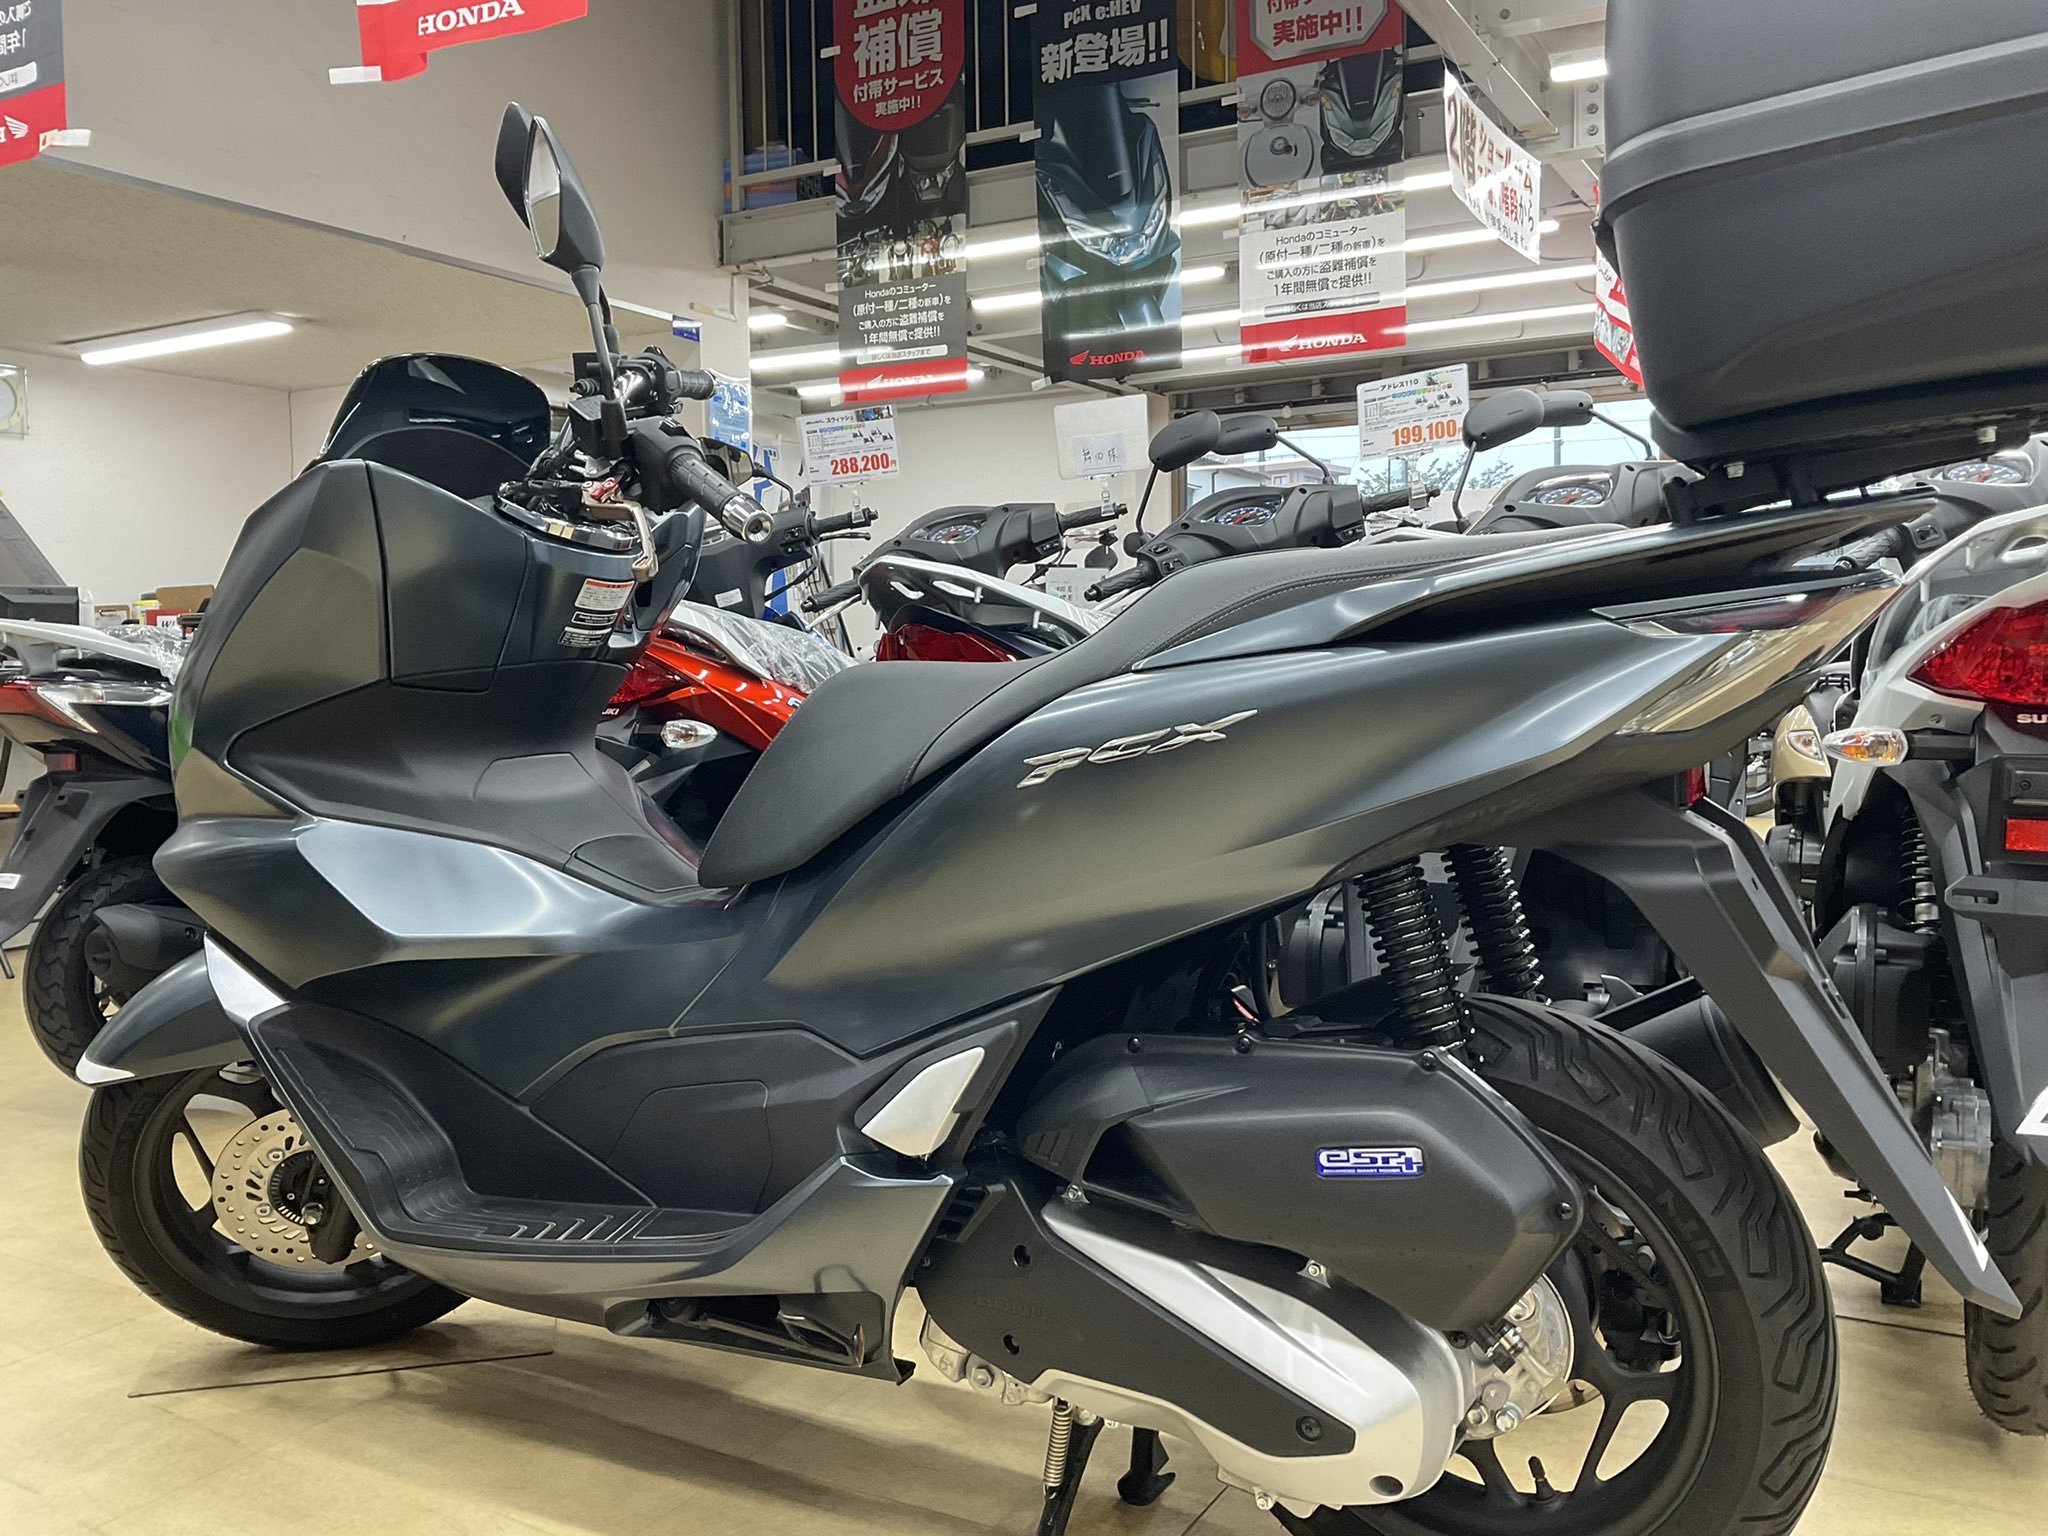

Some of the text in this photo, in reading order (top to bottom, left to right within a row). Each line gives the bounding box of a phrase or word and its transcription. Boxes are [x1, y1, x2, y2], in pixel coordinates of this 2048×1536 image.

[418, 0, 525, 36] HONDA
[1063, 0, 1142, 29] PCX e:HEV
[1273, 6, 1363, 47] 実施中!!
[853, 8, 943, 78] 補償
[1040, 18, 1169, 84] 新登場!!
[853, 68, 944, 104] 付帯サービス
[875, 95, 921, 118] 実施中!!
[1275, 225, 1368, 246] Hondaのコミューター
[1266, 256, 1378, 281] ご購入の方に盗難補償を
[864, 282, 937, 299] Hondaのコミューター
[1273, 272, 1372, 297] 1年間無償で提供!!
[858, 310, 945, 331] ご購入の方に盗難補償を
[863, 325, 941, 345] 1年間無償で提供!!
[1298, 333, 1368, 351] HONDA
[1089, 350, 1147, 366] HONDA
[1380, 378, 1419, 392] アドレス110
[2016, 713, 2048, 724] SU
[1016, 709, 1258, 789] PCX
